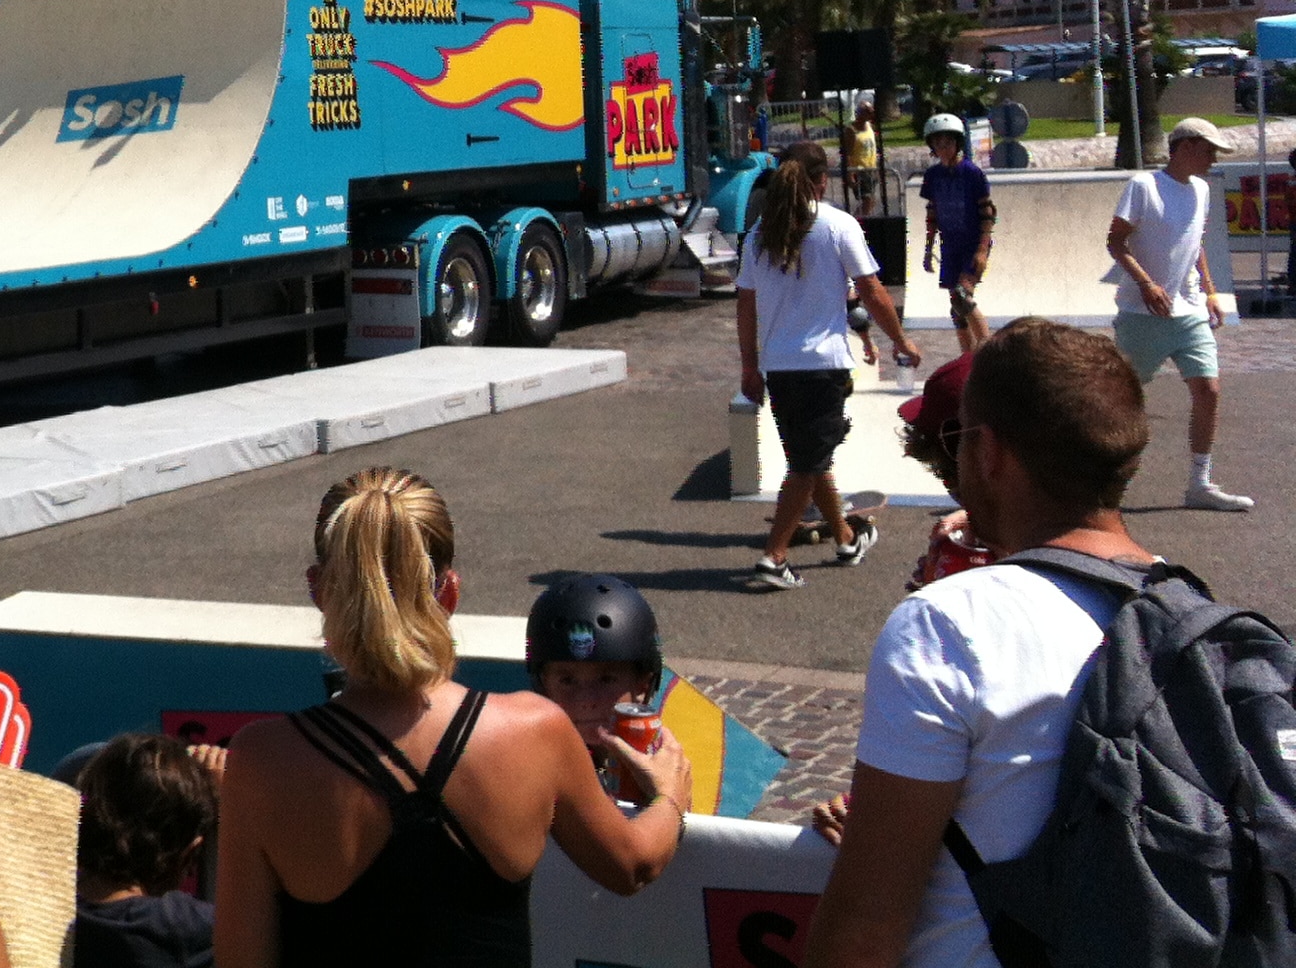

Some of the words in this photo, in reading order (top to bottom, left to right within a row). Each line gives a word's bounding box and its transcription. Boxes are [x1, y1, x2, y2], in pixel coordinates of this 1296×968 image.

[309, 6, 350, 31] ONLY
[306, 32, 355, 58] TRUCK
[309, 73, 356, 99] FRESH
[68, 91, 172, 130] Sosh
[307, 100, 360, 129] TRICKS
[606, 94, 679, 158] PARK
